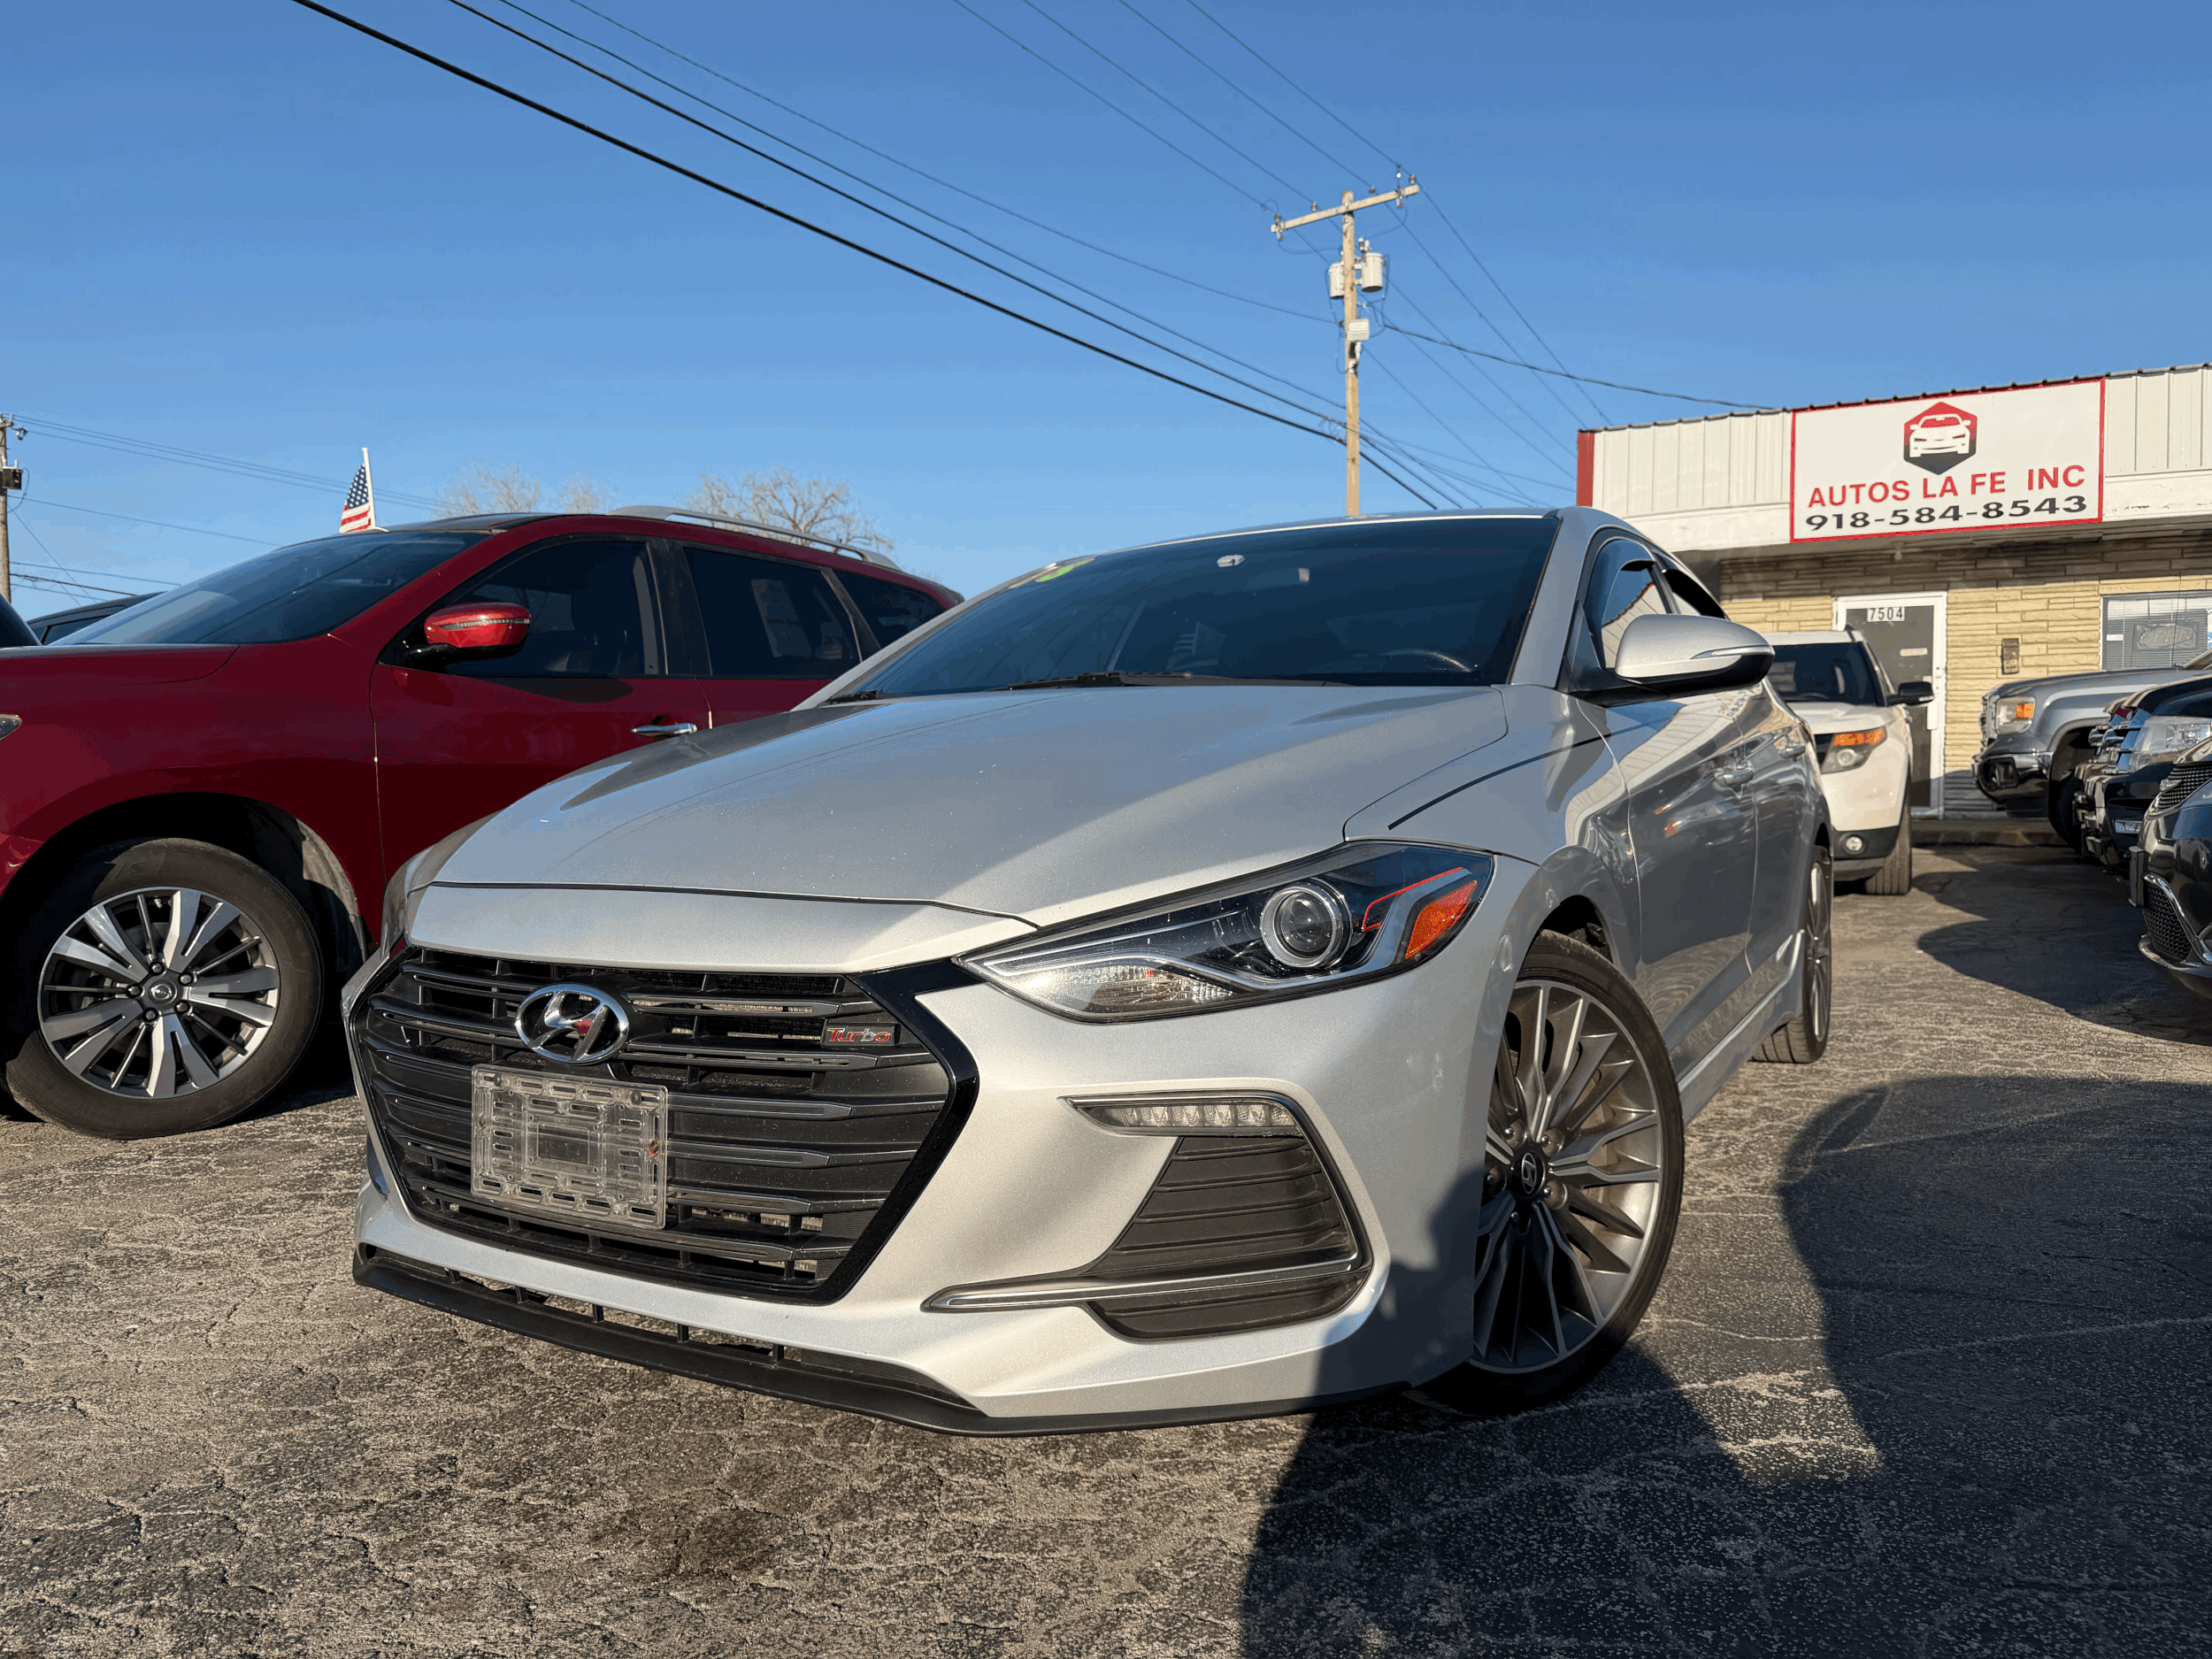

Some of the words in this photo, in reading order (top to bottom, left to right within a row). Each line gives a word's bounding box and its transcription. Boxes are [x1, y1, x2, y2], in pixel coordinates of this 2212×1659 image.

[1808, 480, 1910, 509] AUTOS
[1922, 475, 1959, 500] LA
[1970, 471, 2007, 495] FE
[2027, 464, 2086, 491] INC
[1805, 495, 2087, 532] 918-584-8543
[1869, 606, 1903, 620] 7504
[827, 1027, 891, 1042] Turbo
